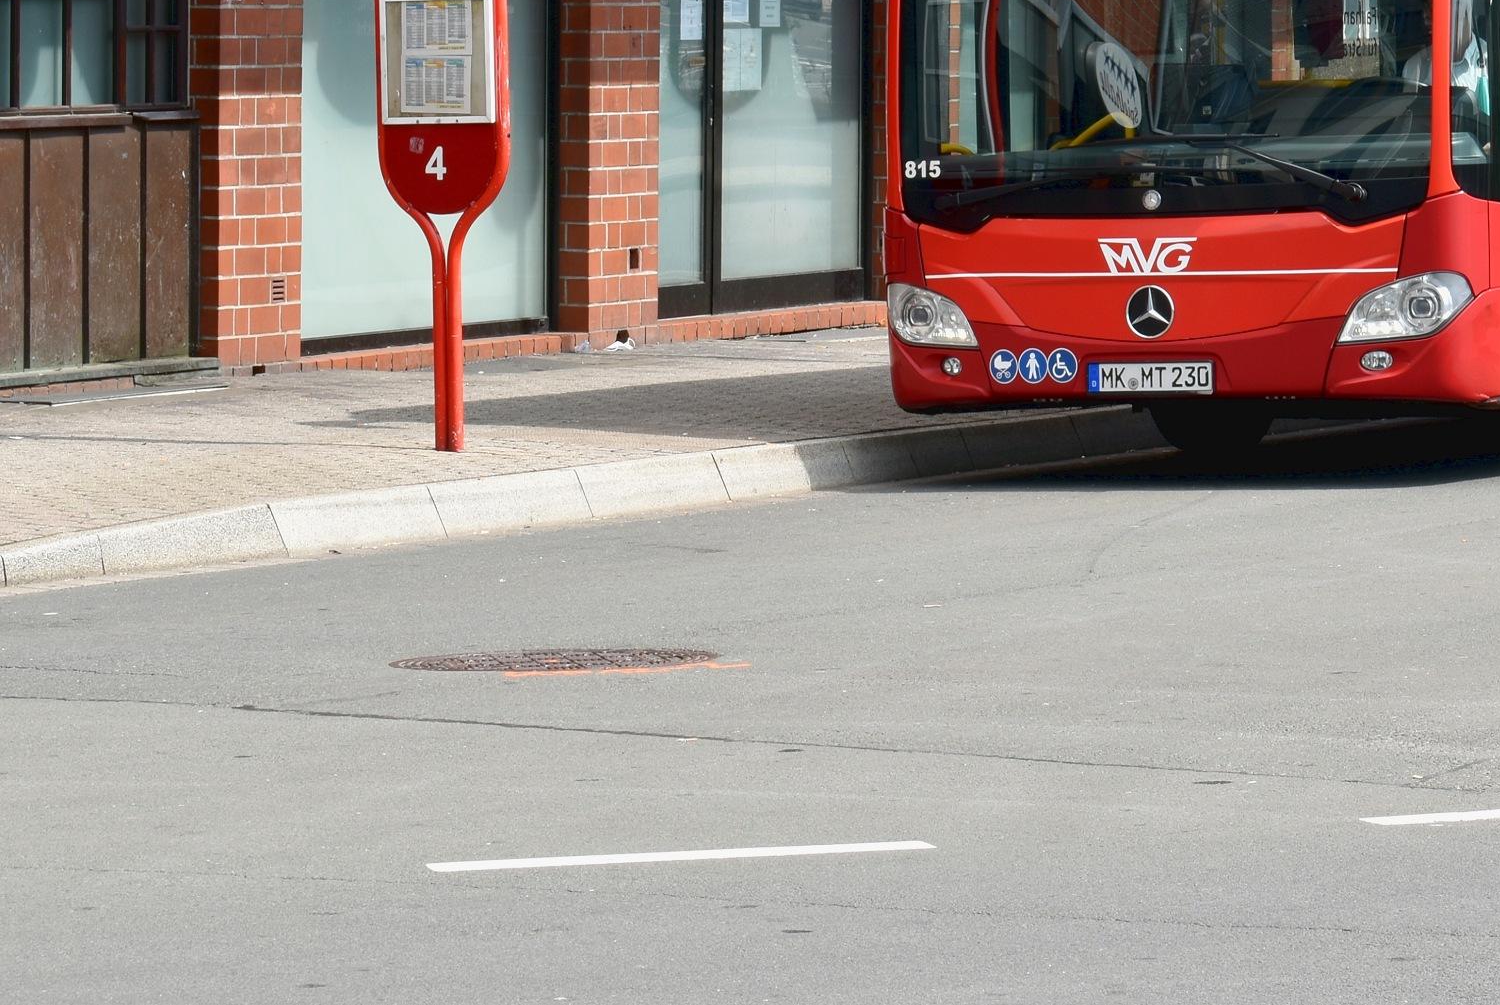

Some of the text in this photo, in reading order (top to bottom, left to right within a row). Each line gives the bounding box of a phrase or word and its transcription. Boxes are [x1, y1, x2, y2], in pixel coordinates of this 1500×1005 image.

[424, 145, 447, 181] 4
[904, 159, 941, 179] 815
[1098, 237, 1197, 274] MVG
[1101, 367, 1126, 389] MK
[1141, 366, 1167, 389] MT
[1171, 366, 1209, 388] 230
